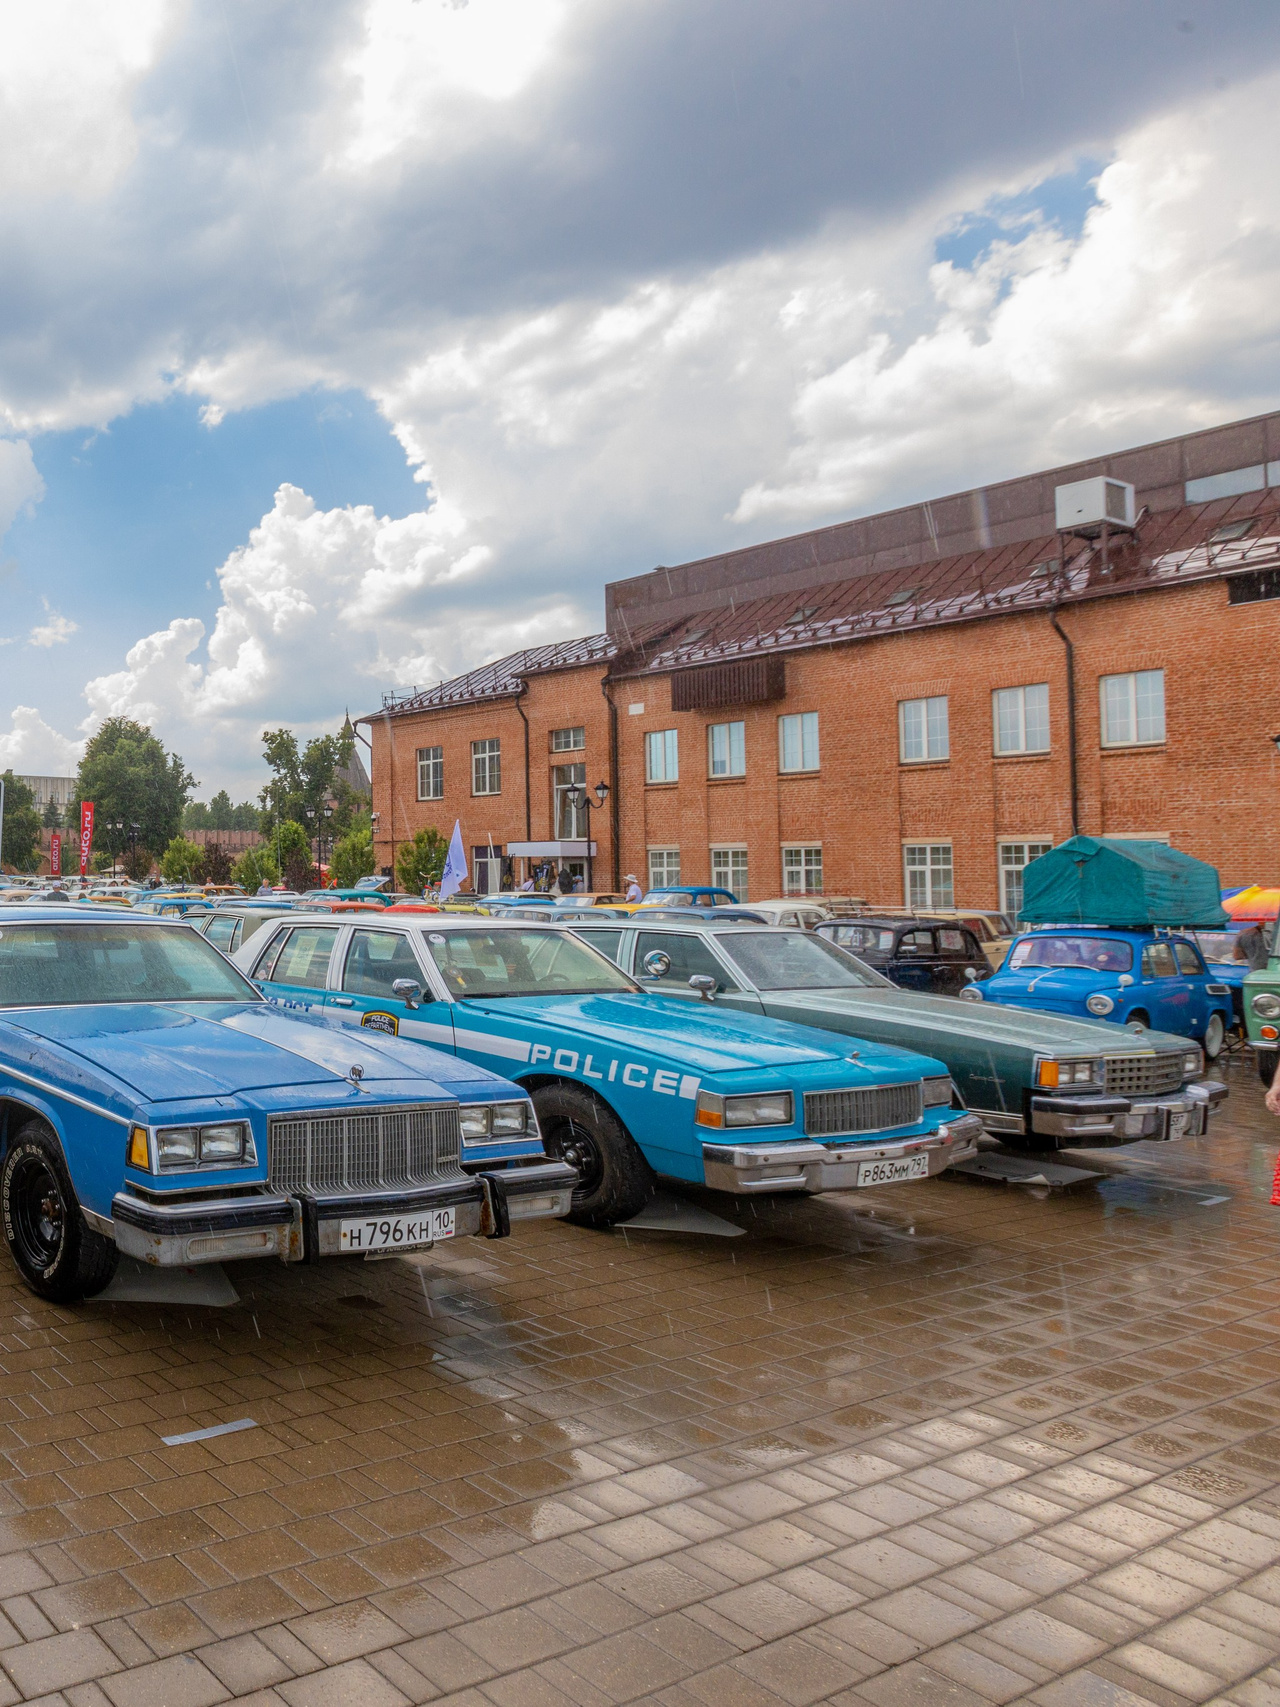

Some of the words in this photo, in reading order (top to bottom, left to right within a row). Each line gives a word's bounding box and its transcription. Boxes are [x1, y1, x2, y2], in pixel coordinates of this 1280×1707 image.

[81, 811, 92, 867] auto.ru
[364, 1021, 395, 1036] DEPARTMENT
[371, 1014, 390, 1025] POLICE
[530, 1043, 680, 1096] POLICE
[3, 1147, 23, 1241] DISCOVERER
[435, 1211, 450, 1230] 10
